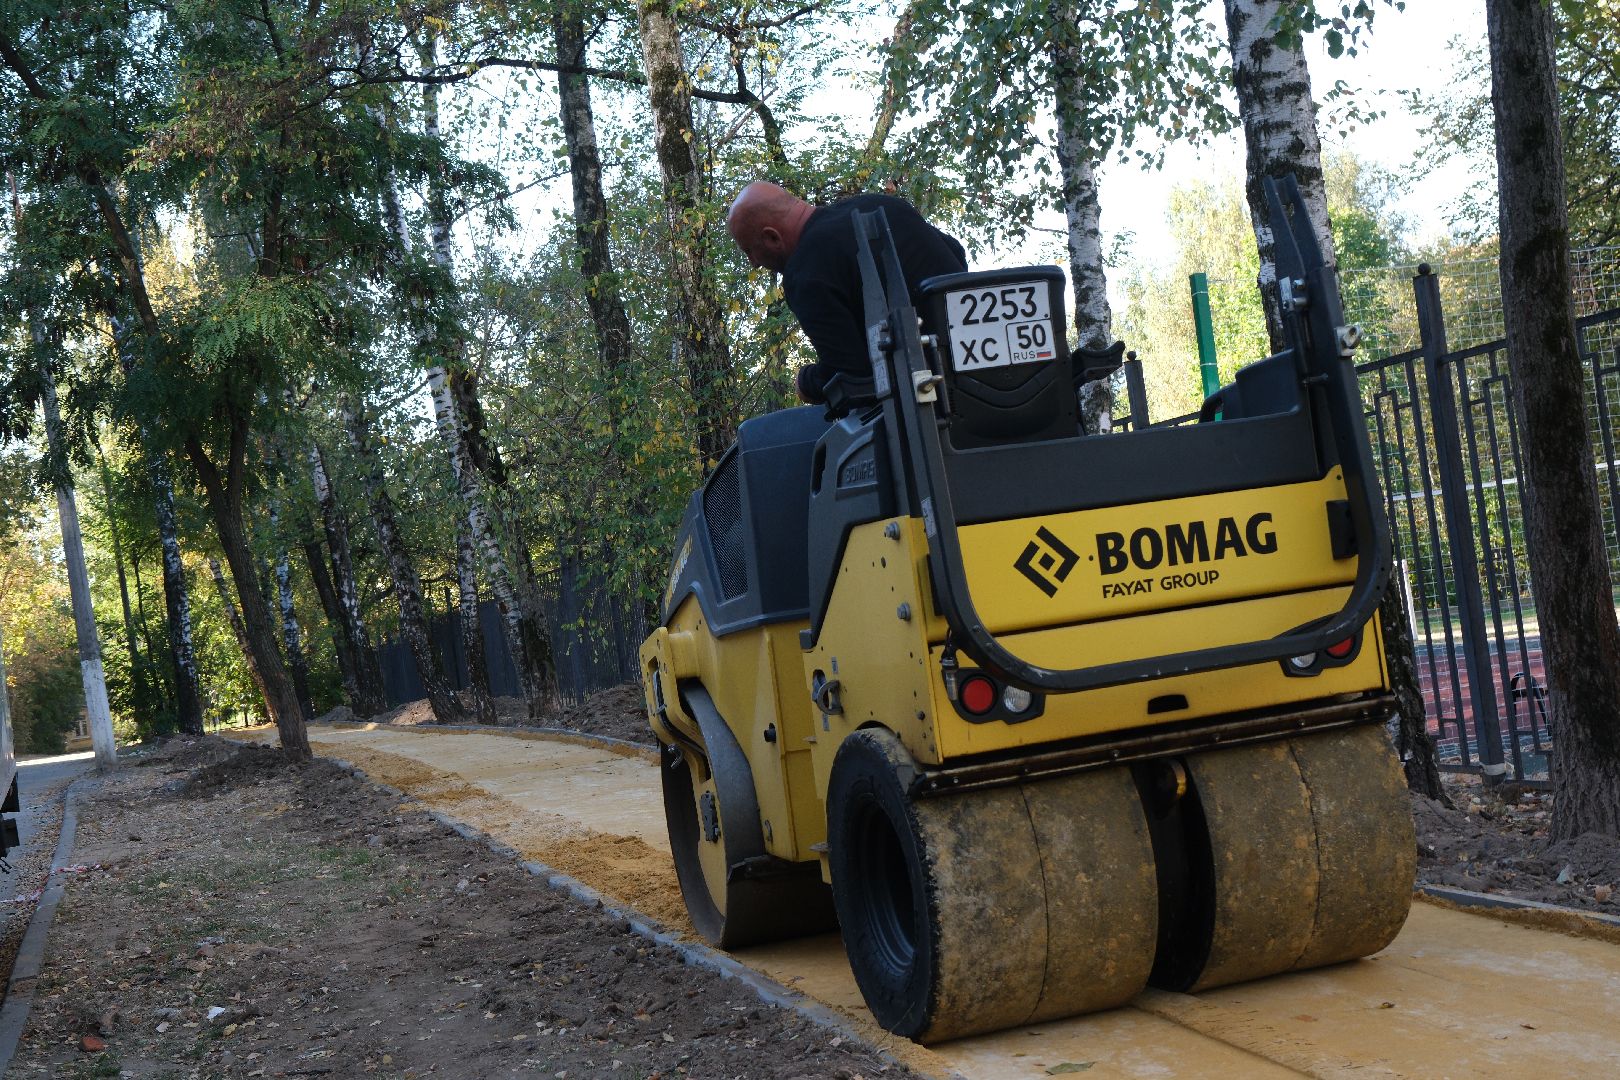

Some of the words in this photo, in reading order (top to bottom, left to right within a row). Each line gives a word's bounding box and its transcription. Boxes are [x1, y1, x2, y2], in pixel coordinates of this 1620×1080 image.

[960, 287, 1037, 326] 2253
[1017, 323, 1047, 349] 50
[1013, 350, 1036, 361] RUS
[1096, 512, 1278, 575] BOMAG
[1102, 578, 1154, 598] FAYAT
[1160, 570, 1220, 590] GROUP
